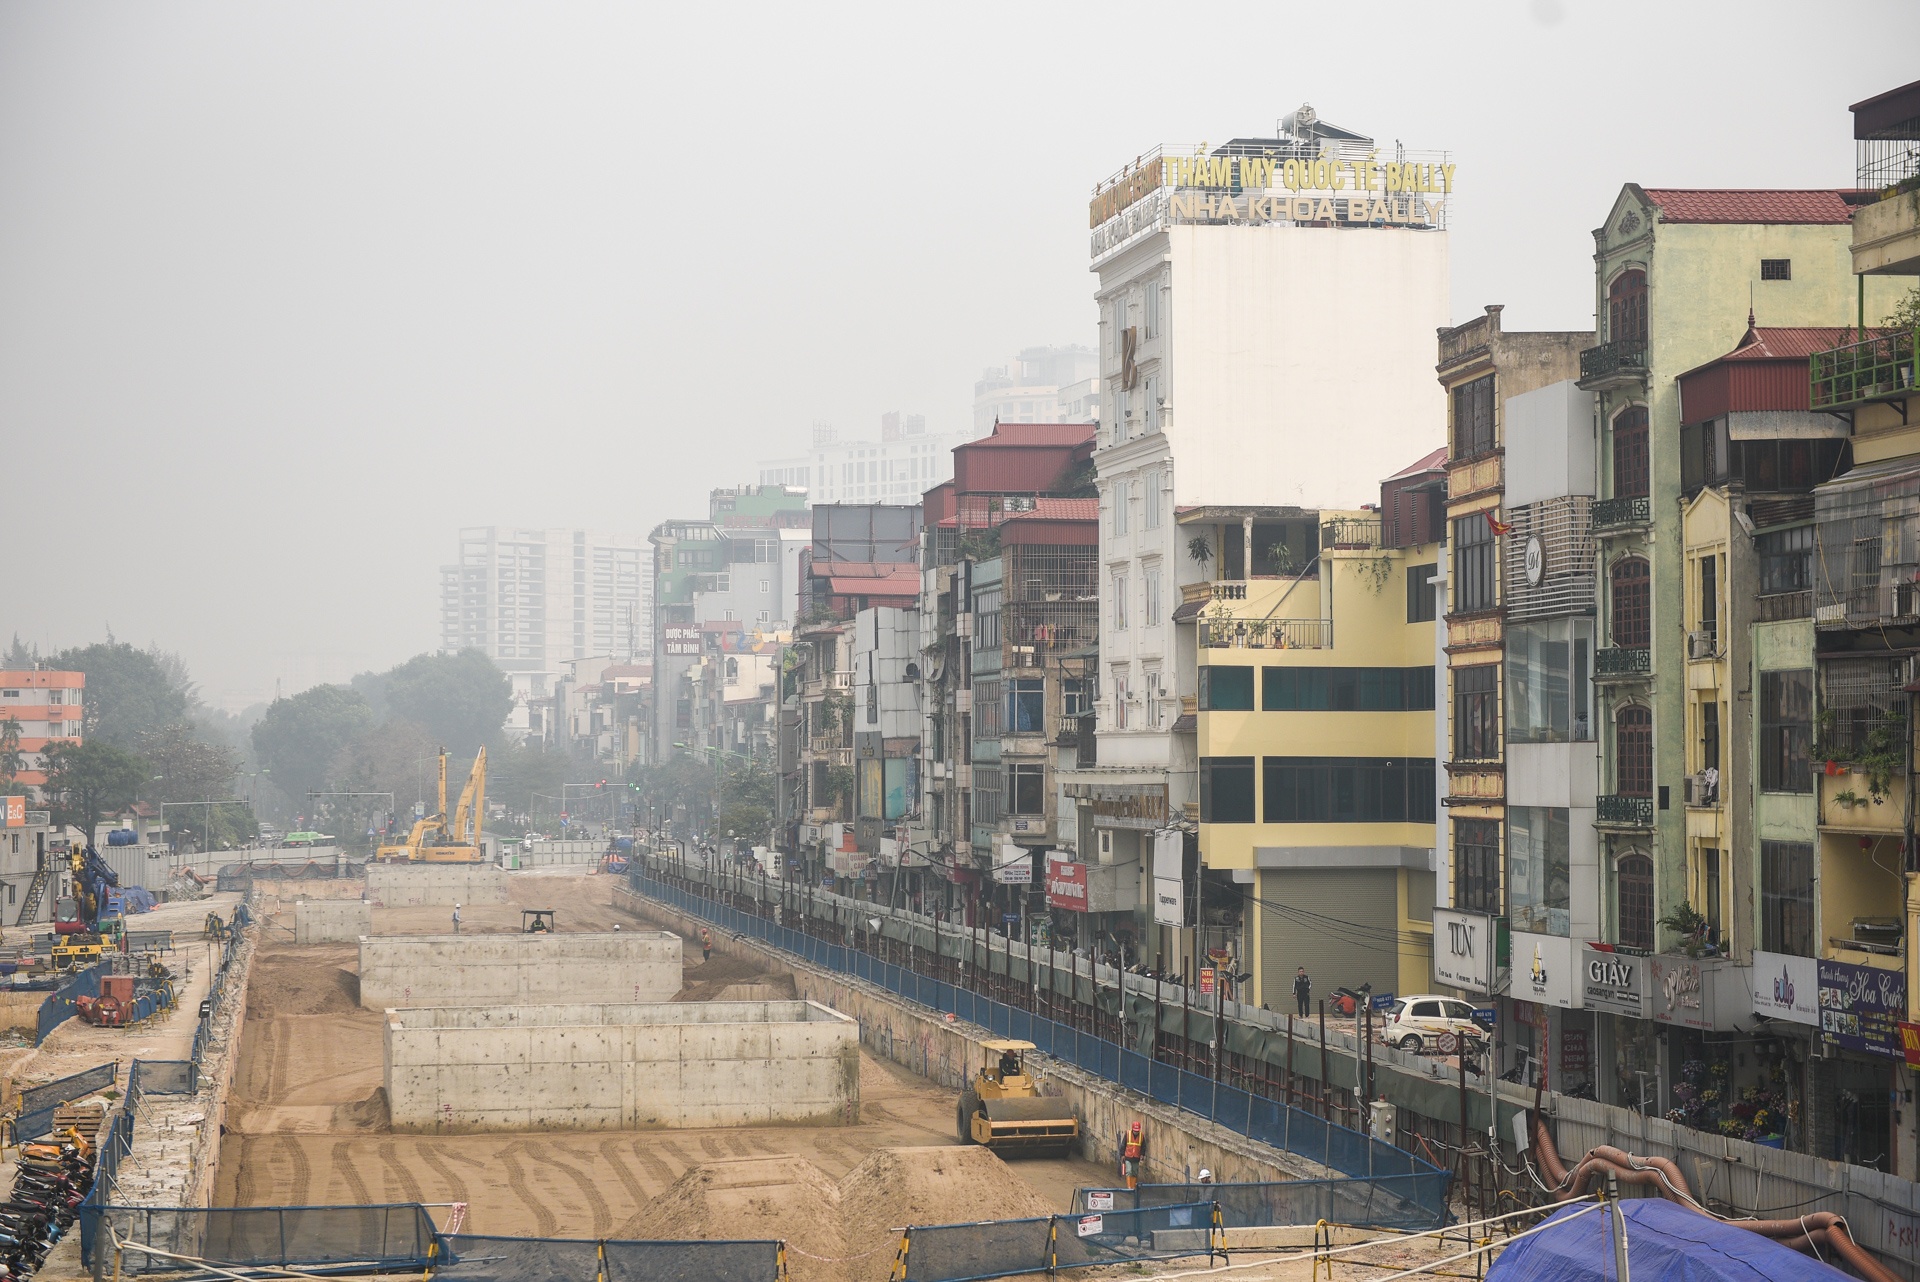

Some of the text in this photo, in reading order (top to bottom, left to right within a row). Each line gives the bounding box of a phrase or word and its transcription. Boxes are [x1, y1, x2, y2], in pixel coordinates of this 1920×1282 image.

[1283, 146, 1345, 193] QUỐC
[1349, 147, 1380, 191] TẾ
[1386, 161, 1456, 193] BALLY
[1169, 195, 1444, 224] NHA KHOA BALLY
[7, 805, 22, 819] E&C
[1849, 971, 1877, 1004] Hoa
